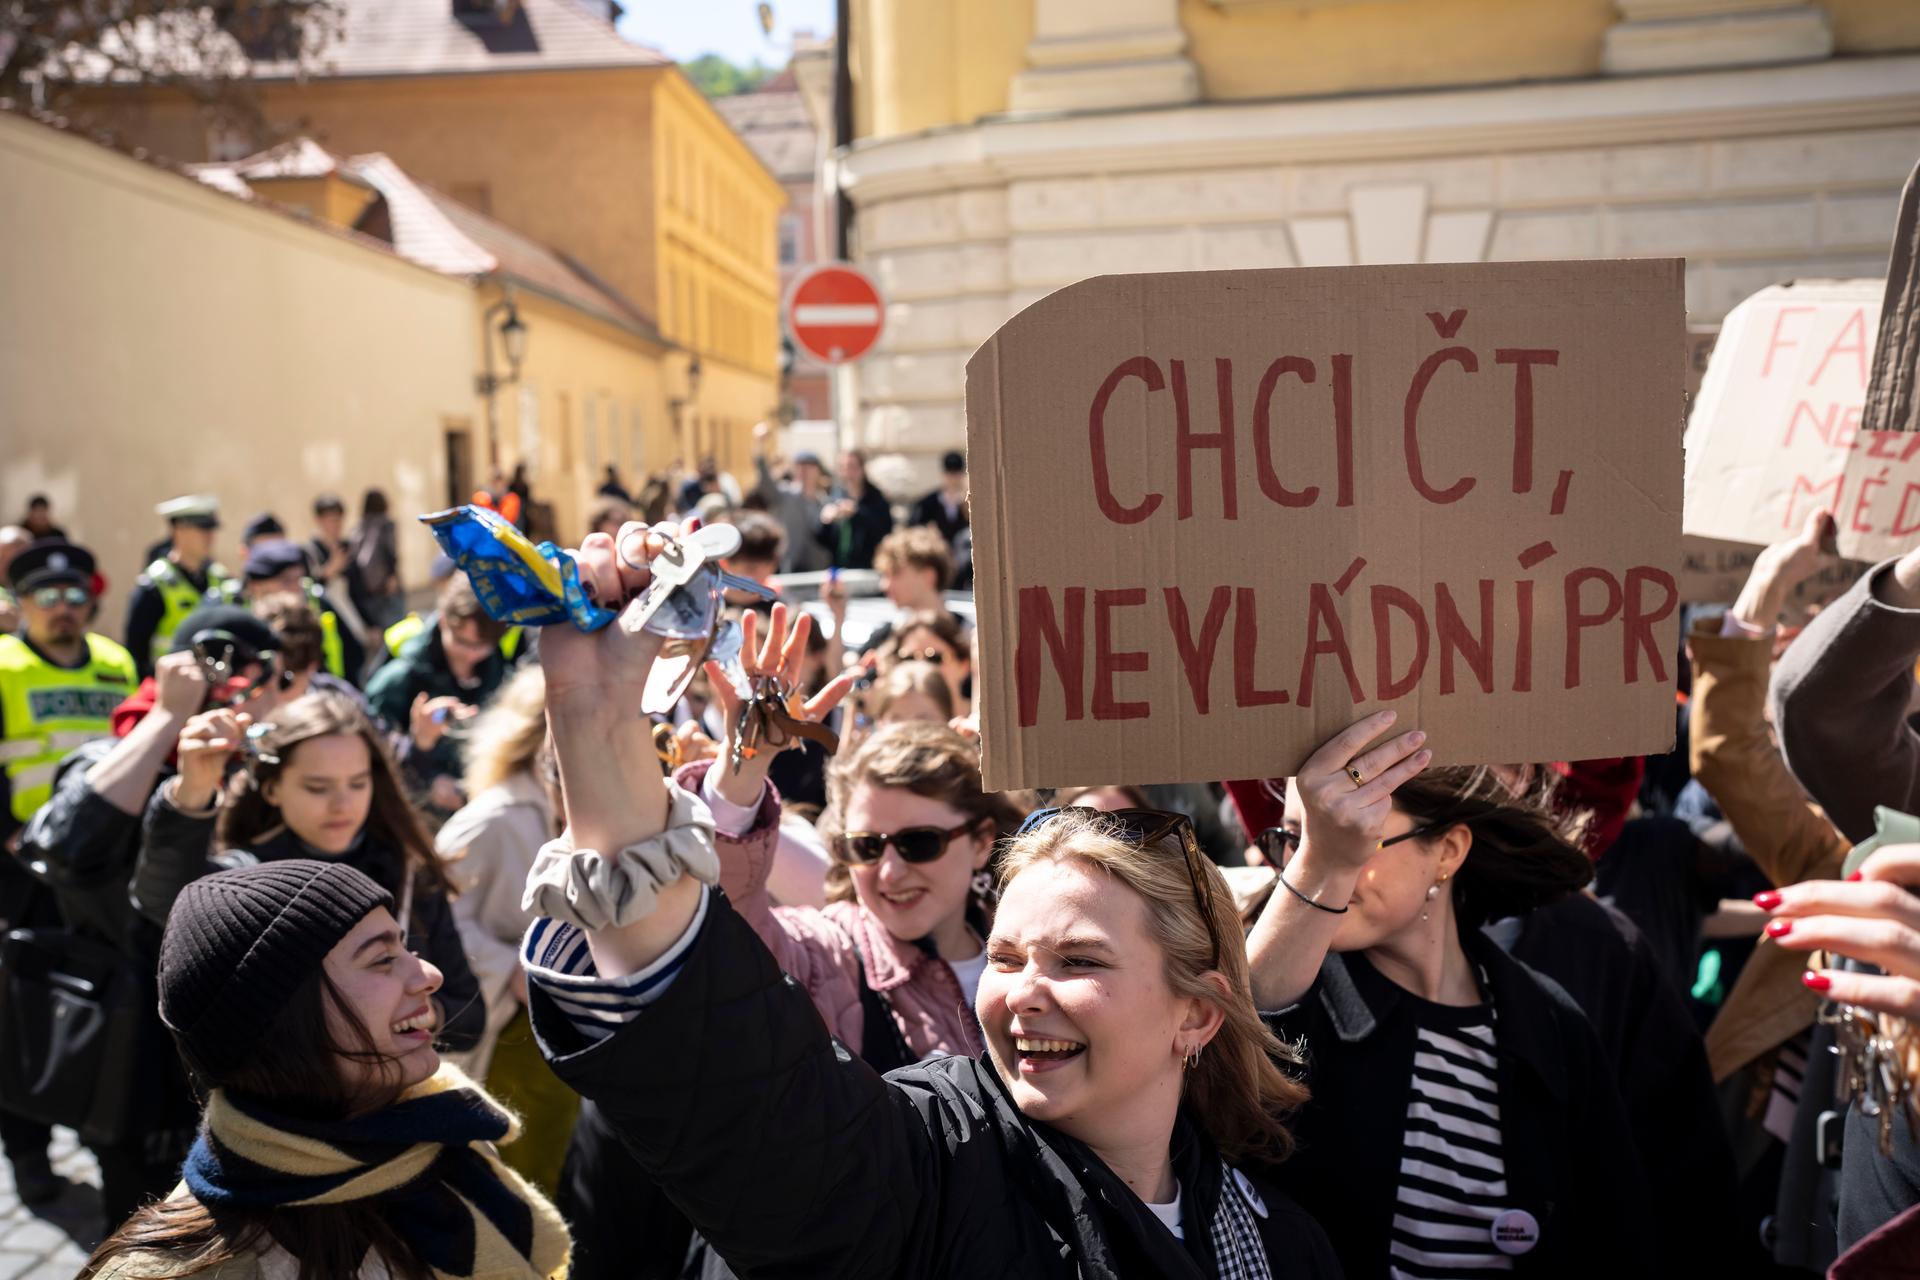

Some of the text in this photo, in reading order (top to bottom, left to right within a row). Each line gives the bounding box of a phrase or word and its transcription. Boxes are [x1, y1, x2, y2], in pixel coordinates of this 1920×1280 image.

[1088, 308, 1575, 524] CHCI ČT,
[1760, 306, 1868, 389] FA
[1014, 540, 1679, 727] NEVLÁDNÍ PR
